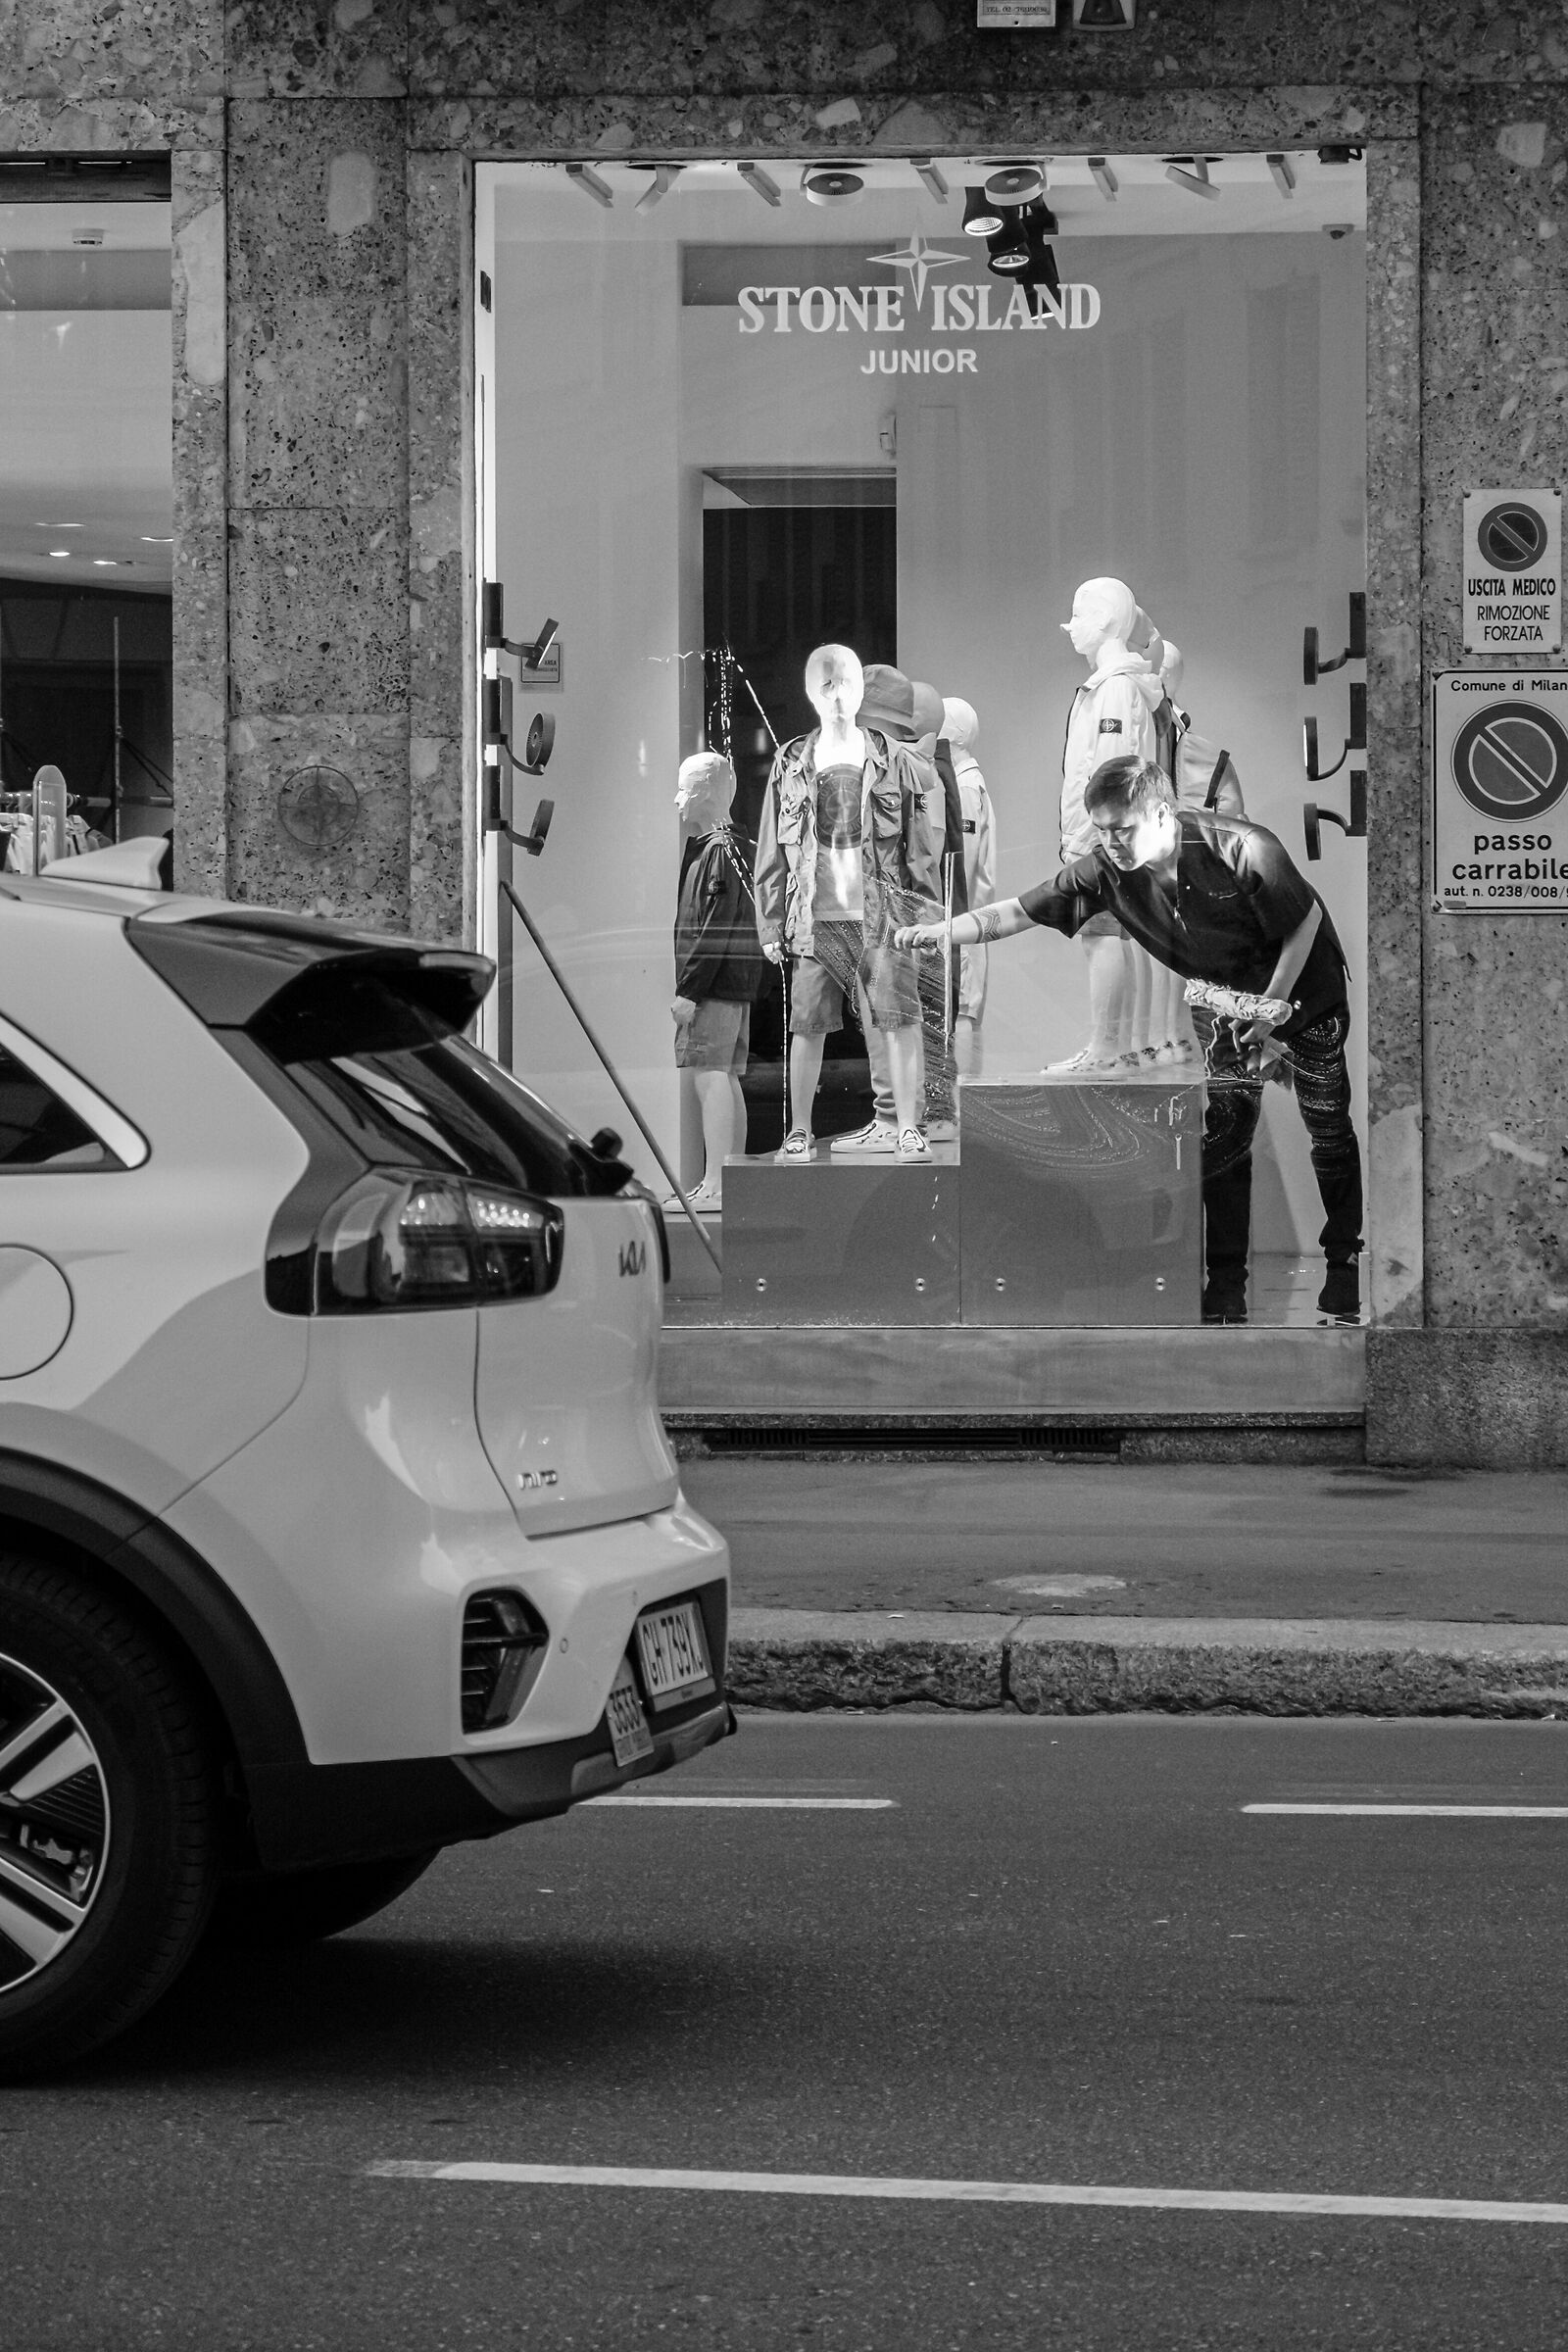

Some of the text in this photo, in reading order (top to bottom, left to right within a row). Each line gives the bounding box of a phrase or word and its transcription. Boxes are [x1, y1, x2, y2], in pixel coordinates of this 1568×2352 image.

[737, 283, 1102, 333] STONE ISLAND
[860, 349, 979, 374] JUNIOR
[1468, 578, 1556, 597] USCITA MEDICO
[1477, 605, 1550, 621] RIMOZIONE
[1484, 625, 1544, 641] FORZATA
[1450, 679, 1568, 692] Comune di Milan
[1474, 834, 1552, 856] passo
[1452, 858, 1568, 881] carrabile
[1444, 886, 1568, 900] aut. n. 0238/008/
[642, 1620, 668, 1687] GH
